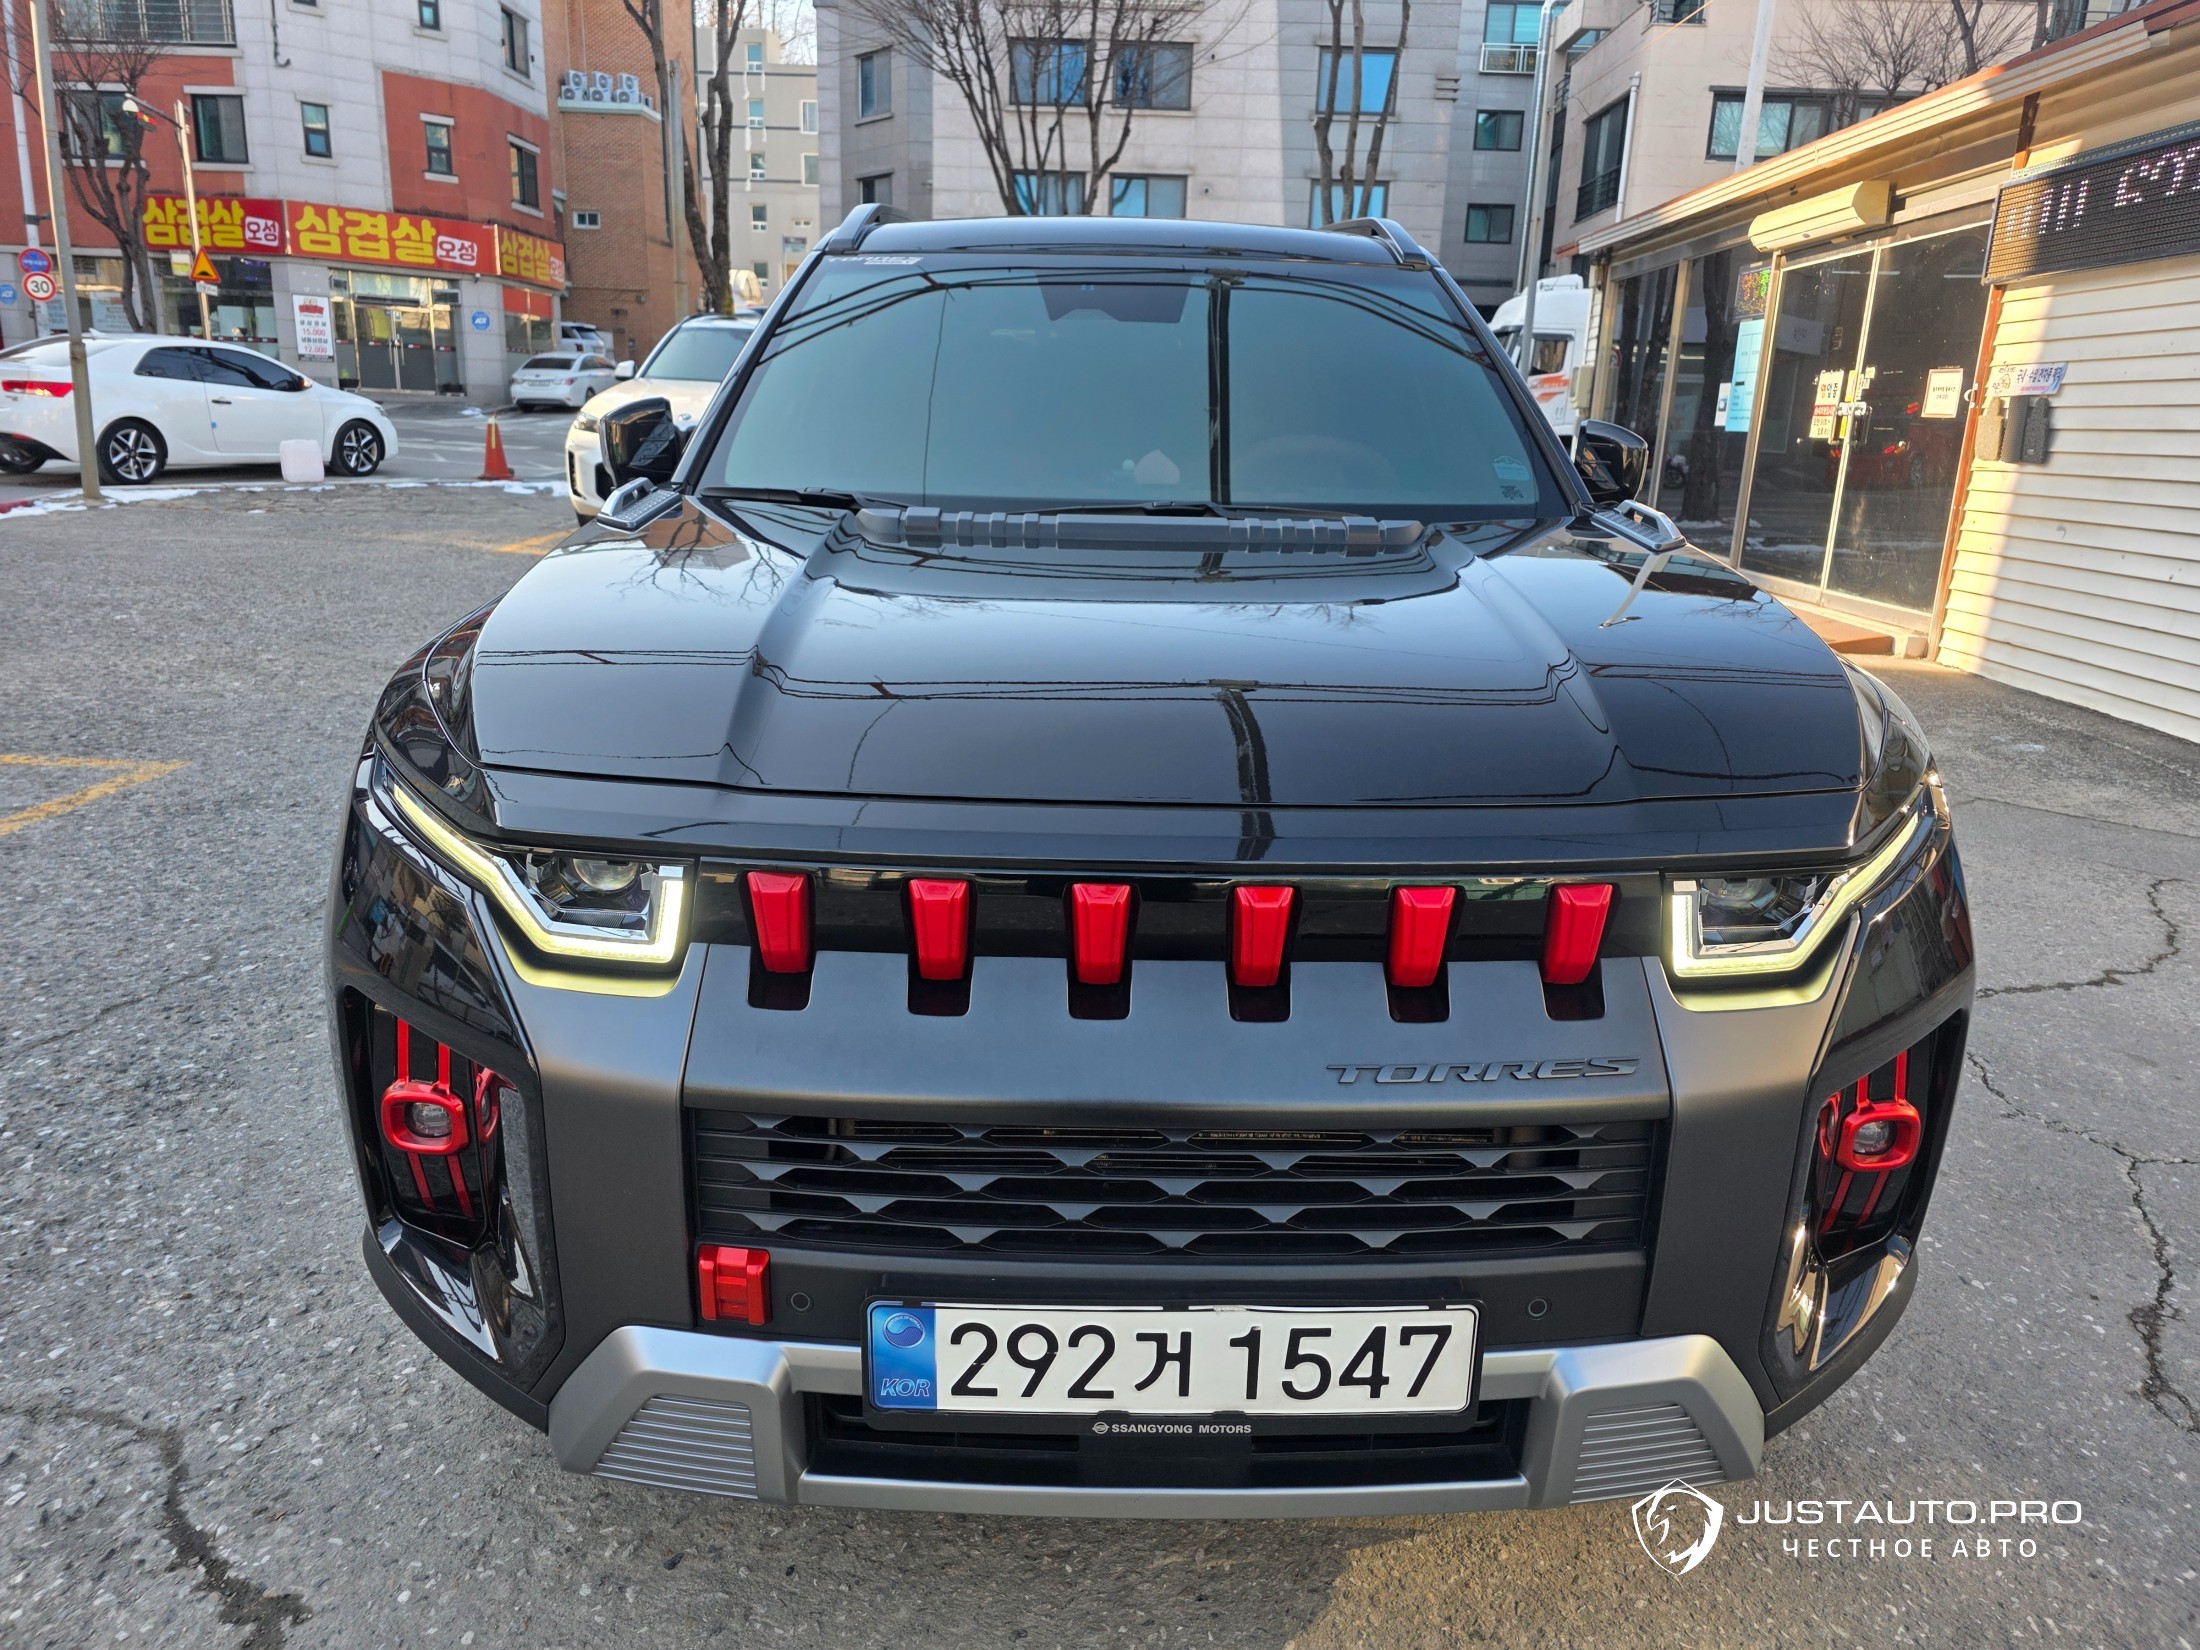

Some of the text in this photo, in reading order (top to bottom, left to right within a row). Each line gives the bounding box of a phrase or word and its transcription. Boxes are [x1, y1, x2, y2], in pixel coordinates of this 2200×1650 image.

[143, 197, 277, 248] 삼겹살 오성
[295, 205, 477, 264] 삼겹살 오성
[501, 230, 551, 281] 삼겹살
[30, 280, 50, 293] 30
[1820, 383, 1838, 399] 영업중
[1326, 1056, 1640, 1084] TORRES
[950, 1322, 1453, 1401] 292거 1547
[881, 1378, 930, 1396] KOR
[1112, 1424, 1252, 1434] SSANGYONG MOTORS
